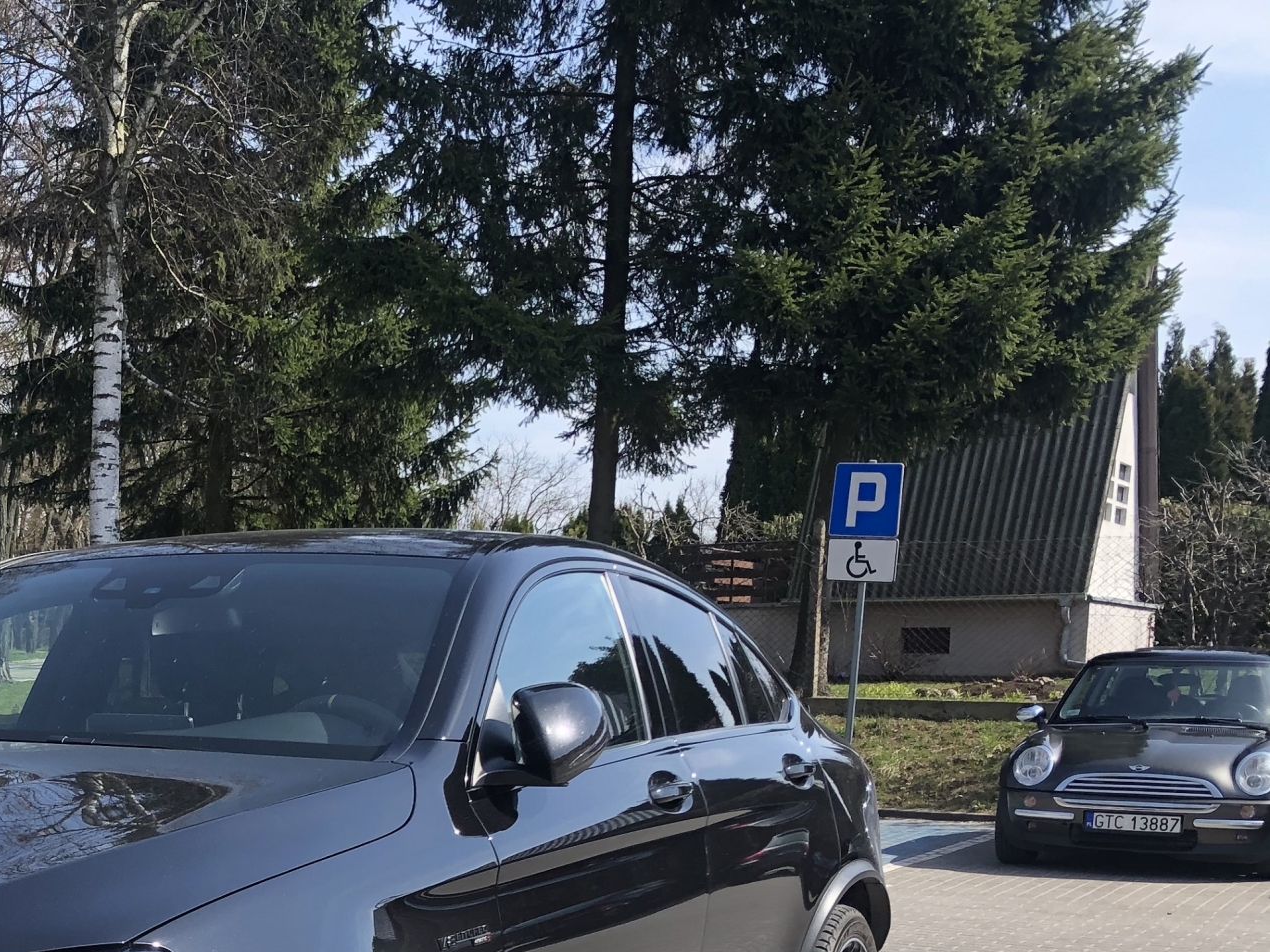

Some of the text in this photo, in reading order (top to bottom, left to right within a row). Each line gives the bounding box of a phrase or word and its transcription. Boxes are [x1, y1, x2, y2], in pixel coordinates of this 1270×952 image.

[845, 471, 887, 527] P
[1094, 813, 1180, 832] GTC 13887
